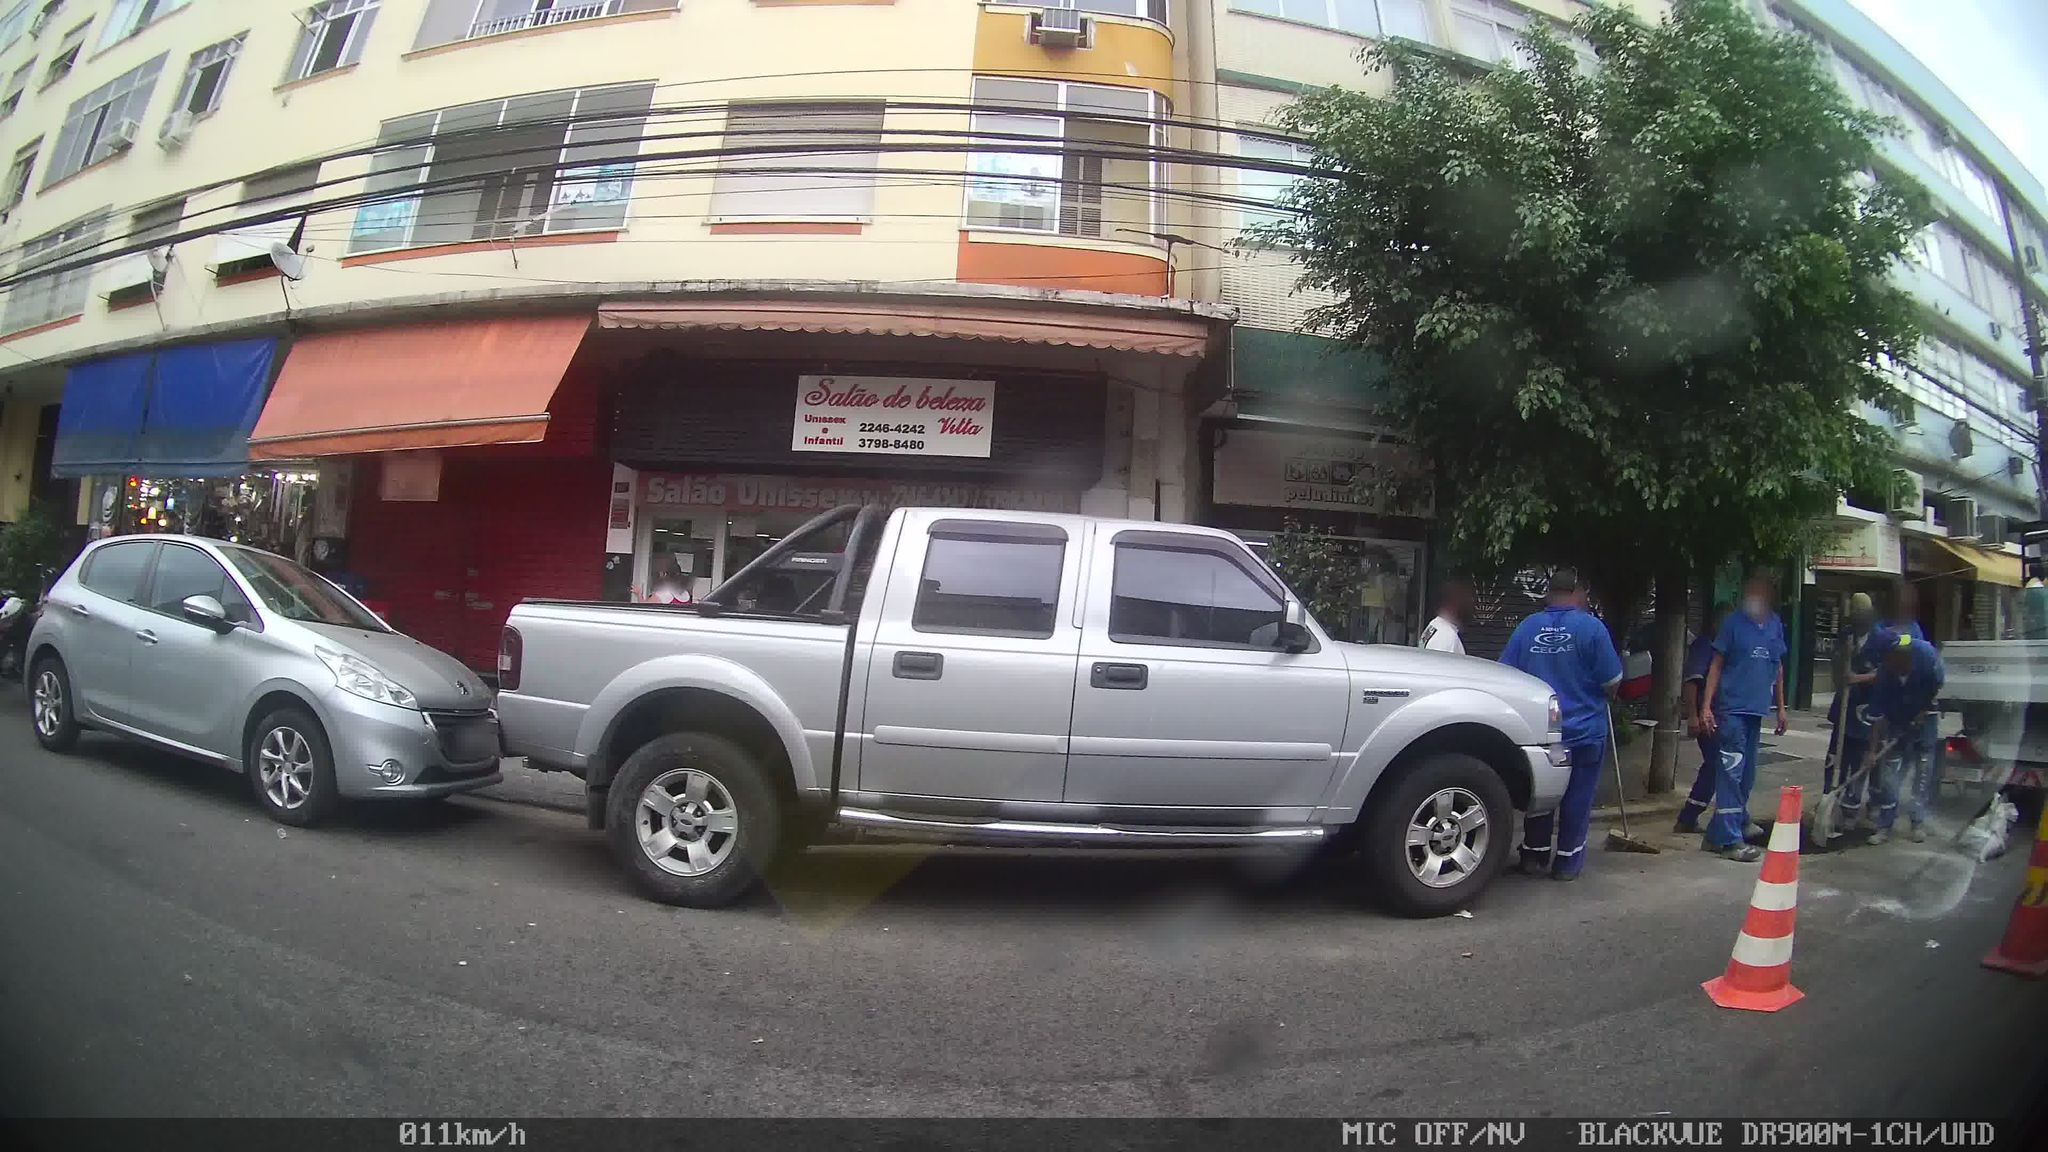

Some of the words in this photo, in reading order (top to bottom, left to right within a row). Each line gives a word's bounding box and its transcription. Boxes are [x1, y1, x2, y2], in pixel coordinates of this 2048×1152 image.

[804, 378, 880, 408] Salão
[883, 384, 912, 409] de
[916, 385, 986, 412] beleza
[804, 414, 847, 424] Unissex
[859, 422, 926, 435] 2246-4242
[804, 436, 844, 446] Infantil
[858, 438, 925, 450] 3798-8480
[647, 475, 726, 505] Salão
